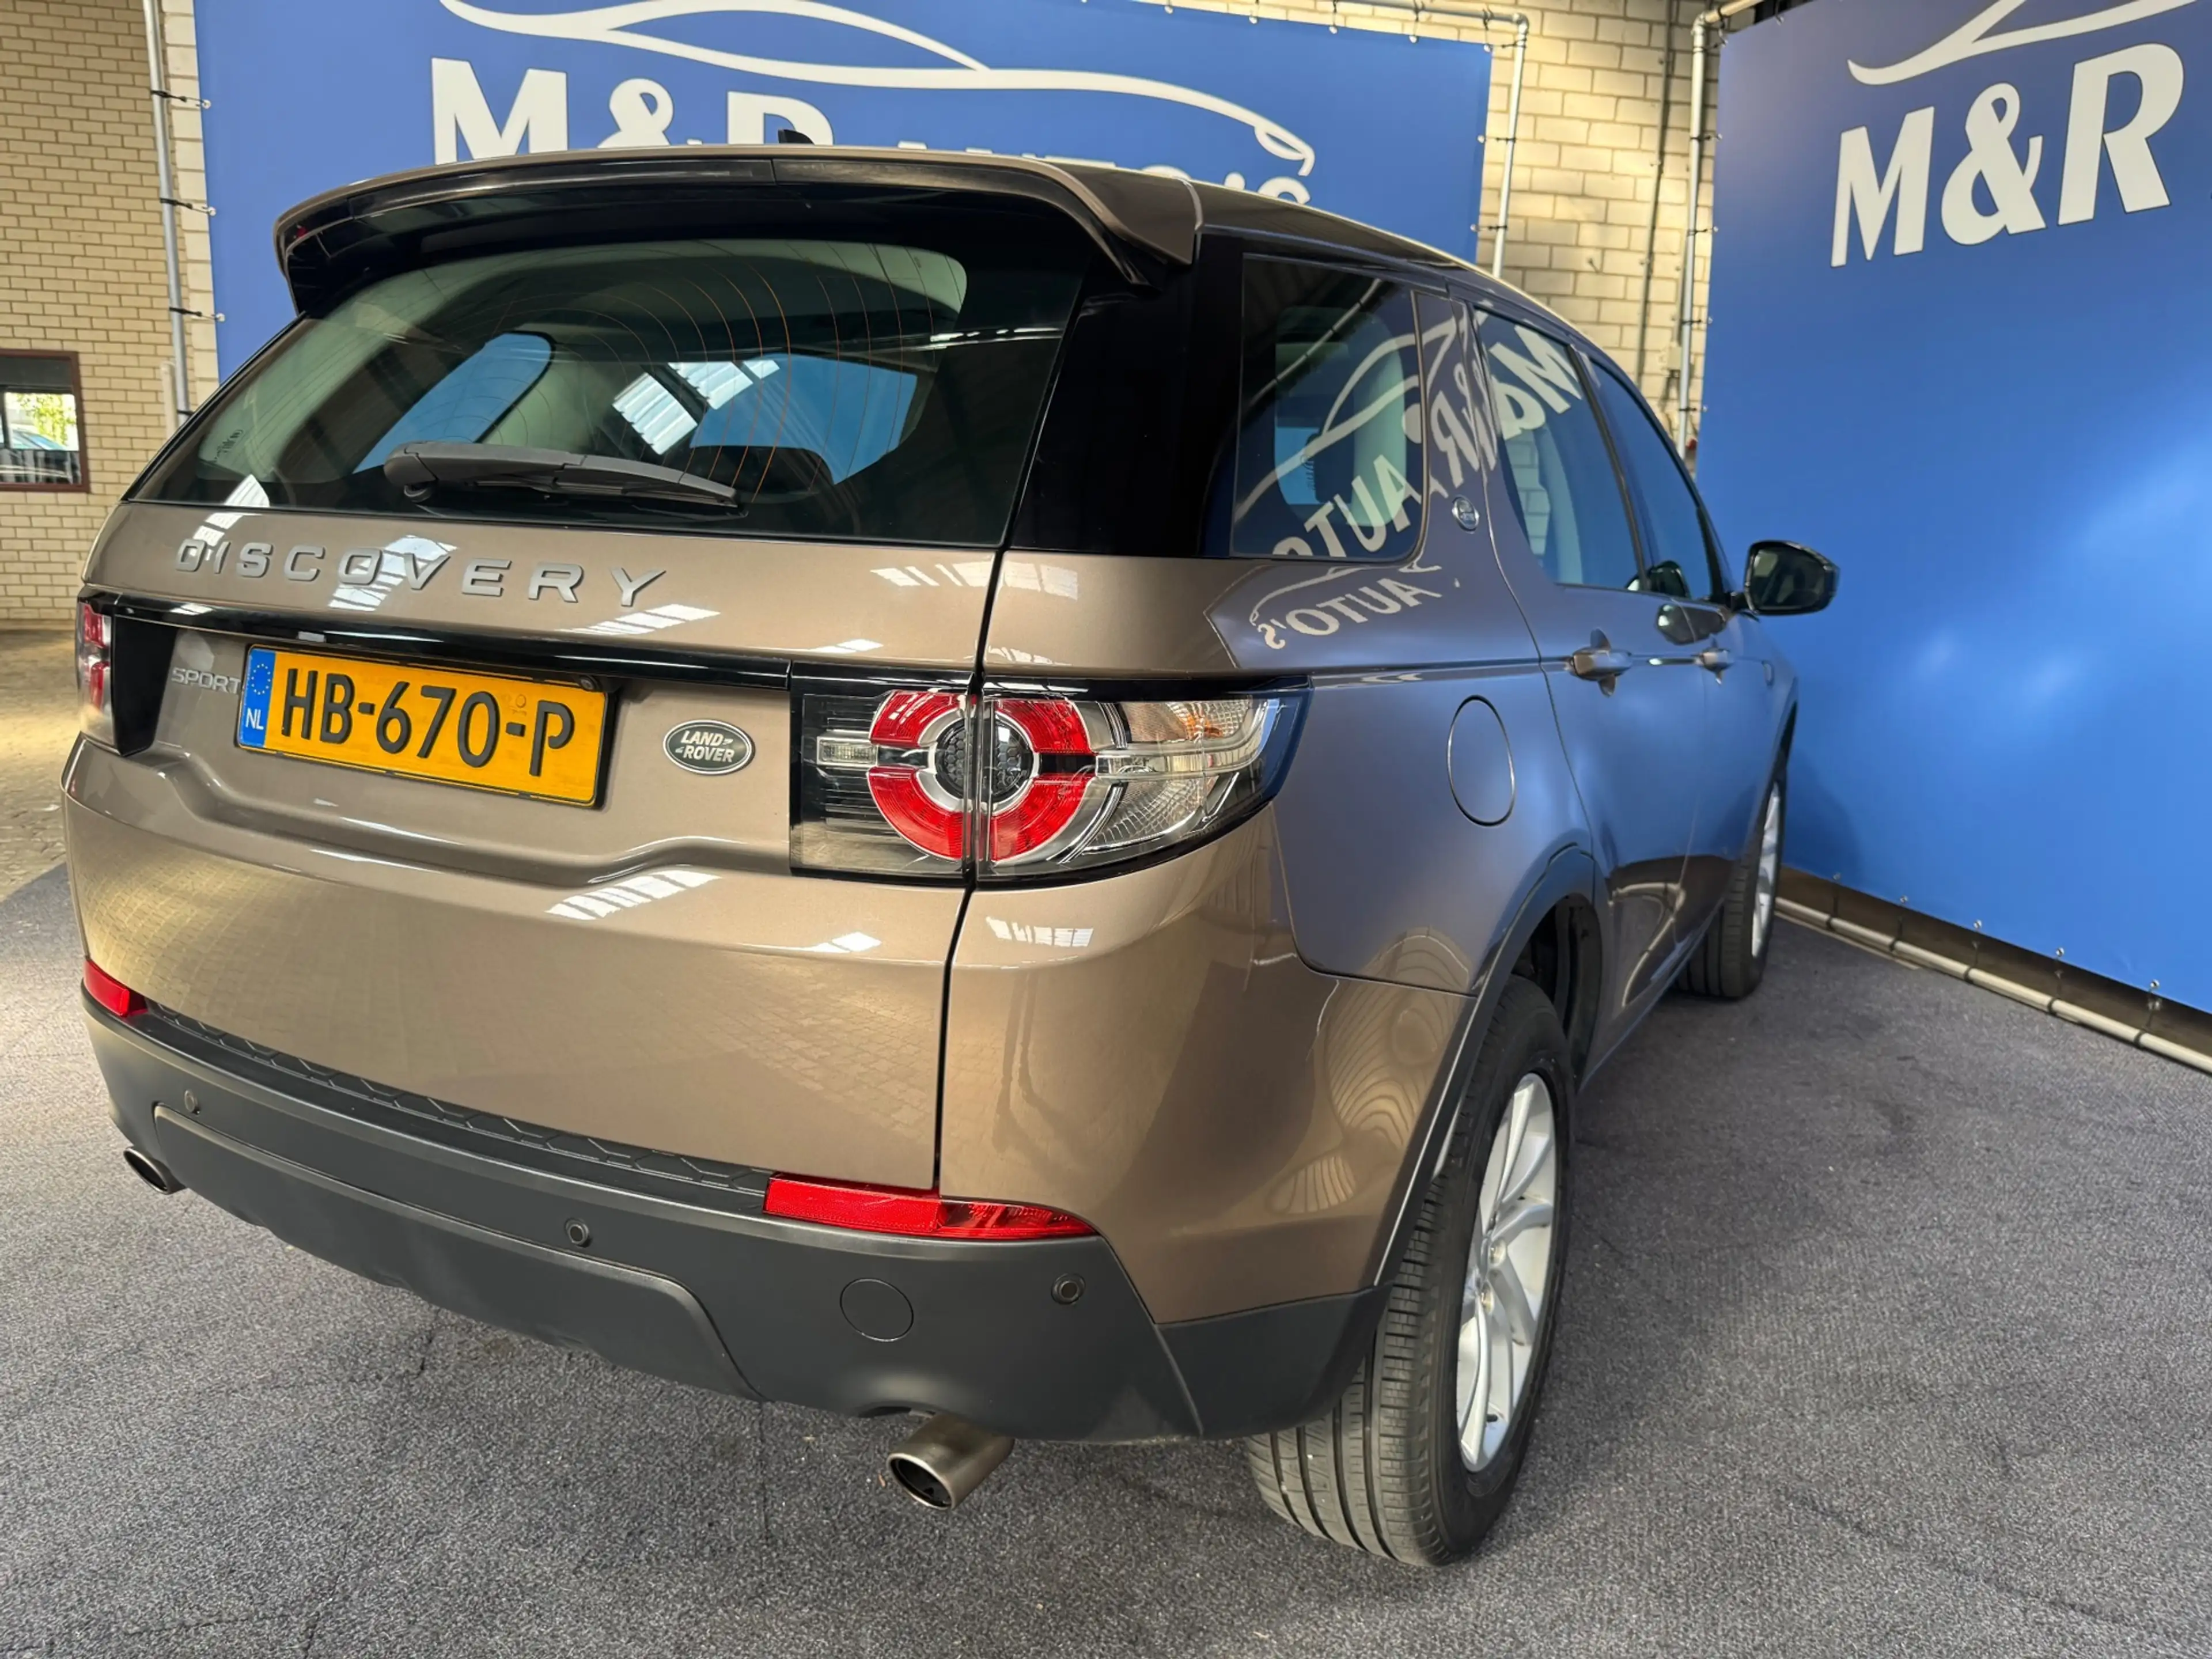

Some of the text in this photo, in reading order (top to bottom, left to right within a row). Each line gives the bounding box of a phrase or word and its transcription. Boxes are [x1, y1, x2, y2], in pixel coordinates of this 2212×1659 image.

[1831, 43, 2184, 268] M&R
[175, 538, 666, 608] DISCOVERY
[171, 666, 241, 695] SPORT
[245, 707, 264, 730] NL
[281, 668, 575, 777] HB-670-P
[681, 730, 724, 747] LAND
[683, 745, 735, 763] ROVER
